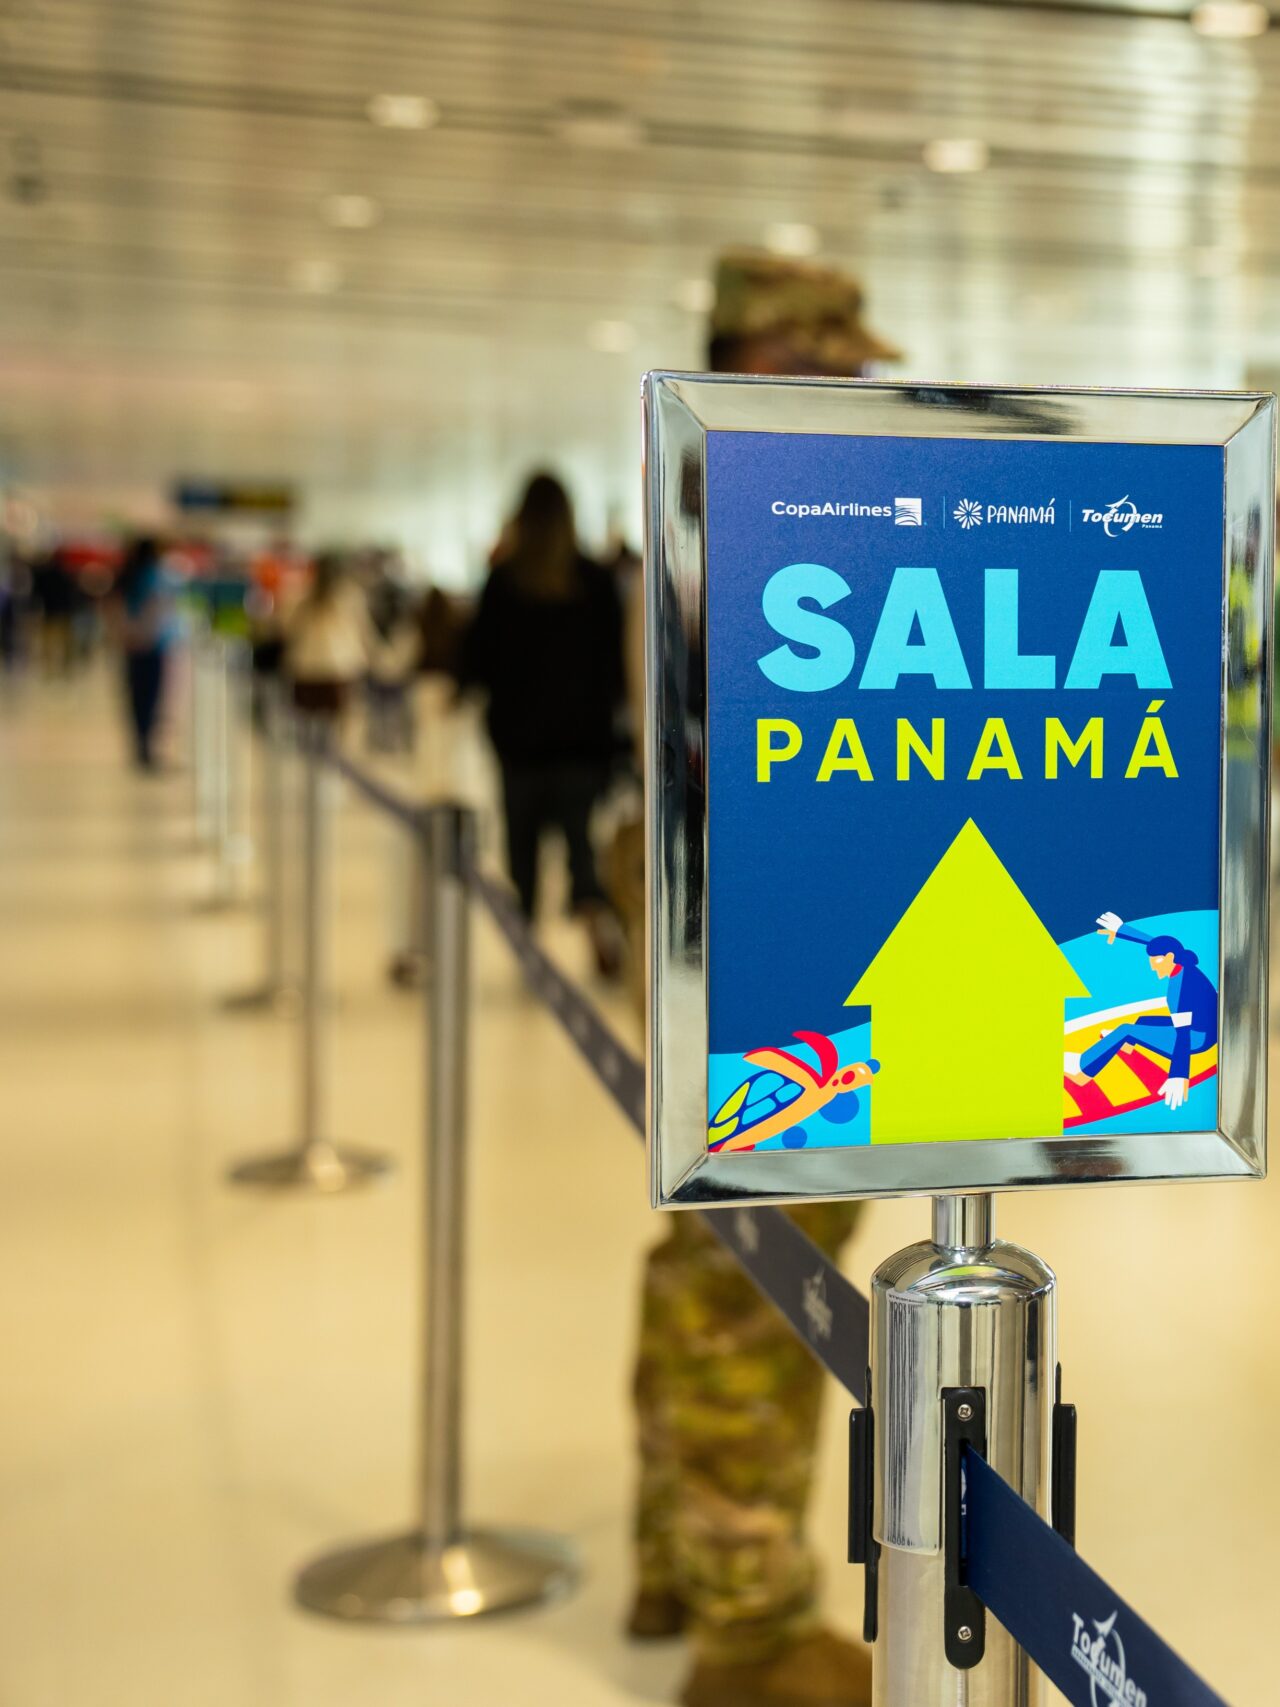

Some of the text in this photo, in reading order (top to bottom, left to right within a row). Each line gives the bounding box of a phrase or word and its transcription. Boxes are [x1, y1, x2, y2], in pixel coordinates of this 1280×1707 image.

[987, 497, 1056, 525] PANAMÁ
[1081, 508, 1164, 524] Tocumen
[756, 563, 1174, 693] SALA
[756, 699, 1179, 783] PANAMÁ
